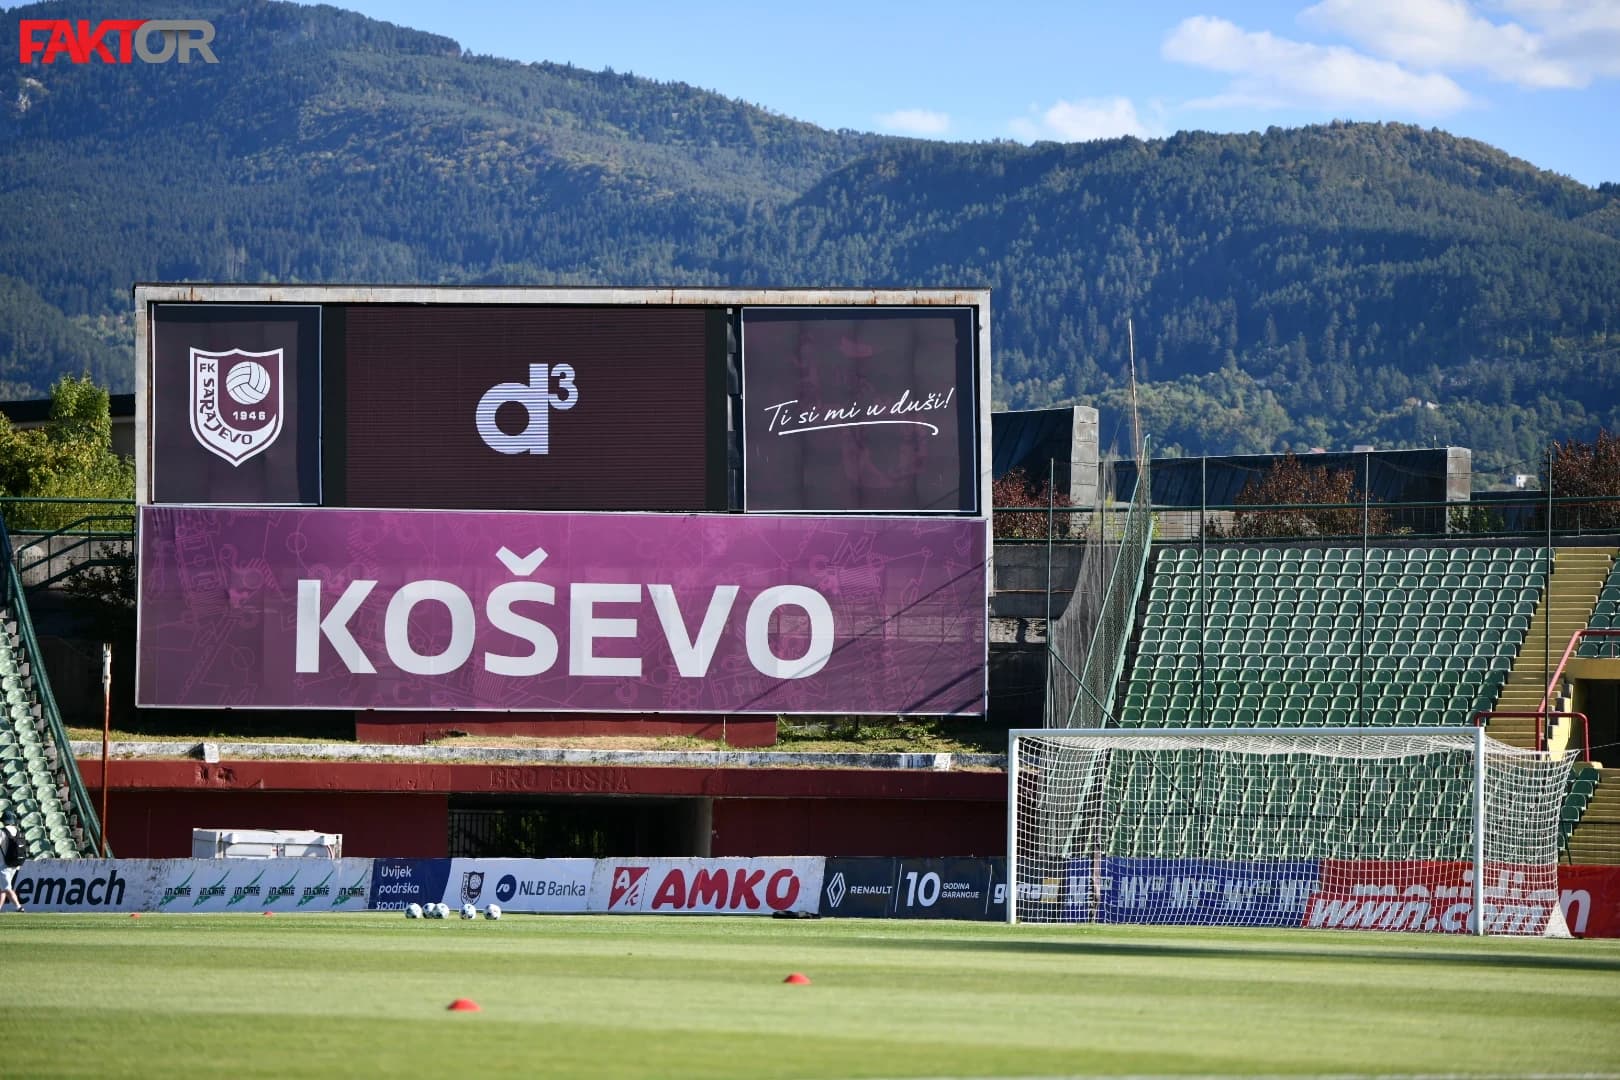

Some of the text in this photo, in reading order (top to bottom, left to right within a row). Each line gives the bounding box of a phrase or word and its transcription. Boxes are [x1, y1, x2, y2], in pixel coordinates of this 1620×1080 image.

[199, 362, 216, 373] FK
[199, 378, 253, 445] SARAJEVO
[764, 387, 955, 432] Ti si mi u duši!
[295, 546, 835, 680] KOŠEVO
[381, 865, 413, 882] Uvijek
[379, 882, 420, 895] podrška
[519, 880, 586, 896] NLB Banka
[651, 868, 800, 911] AMKO
[850, 885, 893, 895] RENAULT
[905, 871, 941, 907] 10
[943, 882, 970, 890] GODINA
